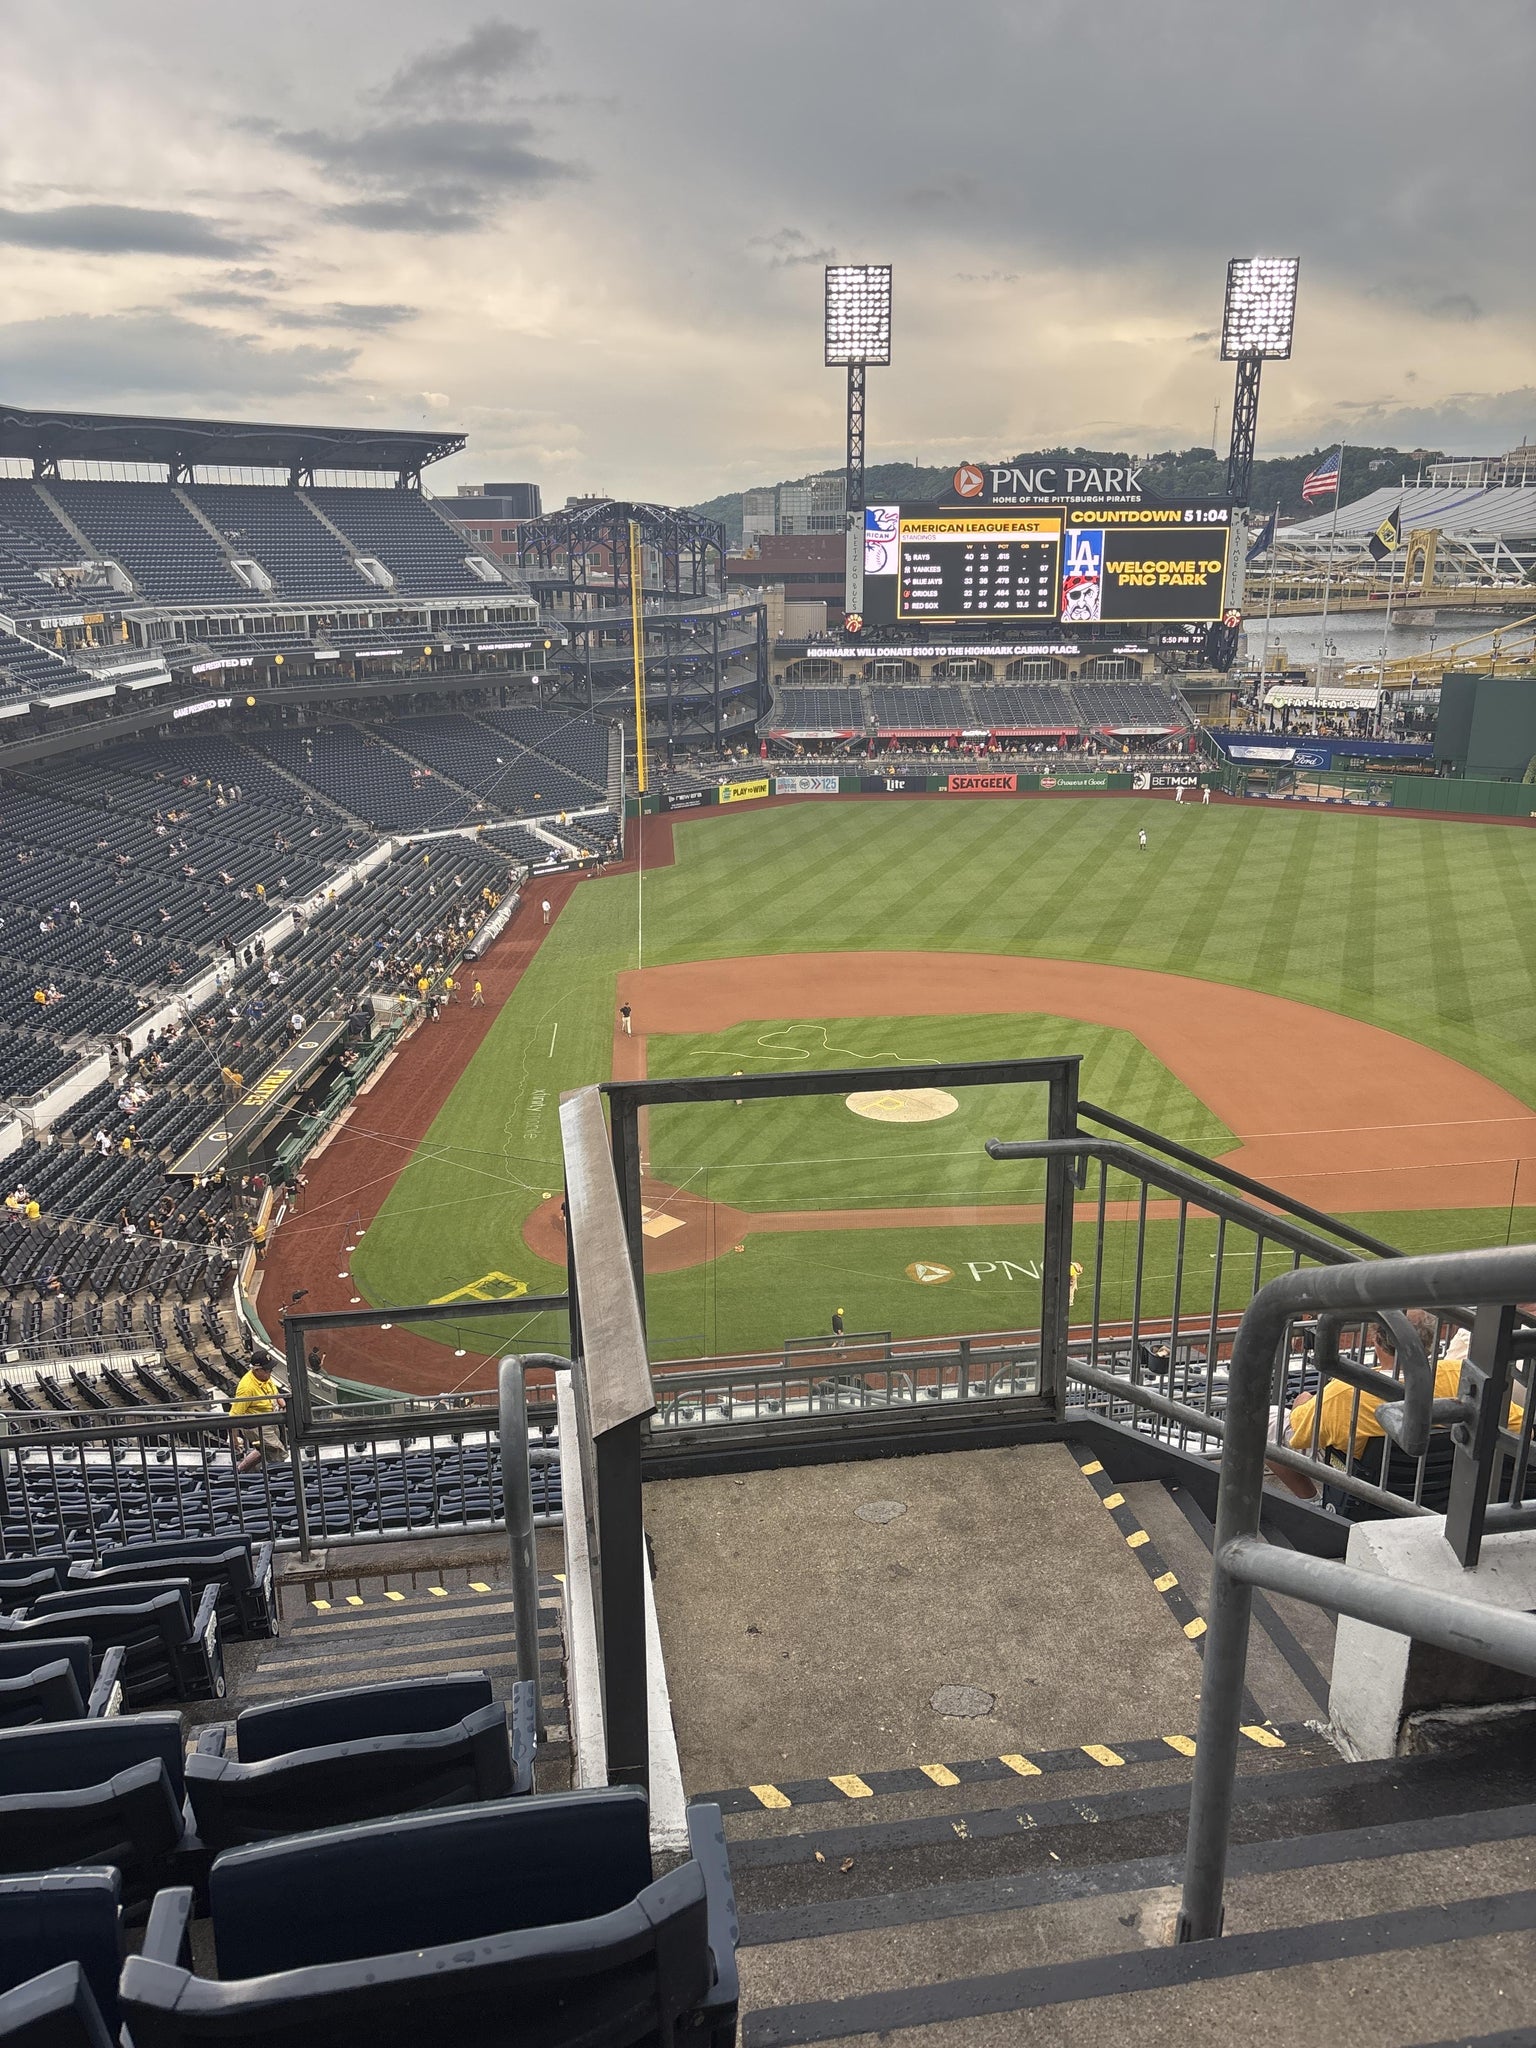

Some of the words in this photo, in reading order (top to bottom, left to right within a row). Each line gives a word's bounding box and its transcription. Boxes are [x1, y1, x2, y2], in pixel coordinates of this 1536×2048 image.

[990, 468, 1056, 494] PNC
[1064, 467, 1144, 492] PARK
[1052, 495, 1104, 503] PITTSBURGH
[1071, 510, 1182, 522] COUNTDOWN
[1184, 509, 1228, 522] 51:04
[902, 524, 964, 533] AMERICAN
[966, 523, 1009, 532] LEAGUE
[1011, 523, 1040, 532] EAST
[1105, 561, 1195, 573] WELCOME
[1198, 561, 1221, 573] TO
[1118, 574, 1157, 586] PNC
[1159, 574, 1207, 586] PARK
[1162, 636, 1177, 644] 5:50
[1177, 636, 1189, 644] PM
[807, 649, 856, 657] HIGHMARK
[857, 648, 876, 657] WILL
[877, 647, 912, 656] DONATE
[913, 647, 934, 656] $100
[935, 647, 946, 655] TO
[947, 647, 964, 655] THE
[964, 646, 1014, 655] HIGHMARK
[1014, 646, 1049, 654] CARING
[1050, 645, 1080, 654] PLACE.
[240, 658, 254, 666] BY
[218, 698, 233, 708] BY
[1294, 754, 1317, 765] Ford
[821, 778, 837, 789] 125
[886, 779, 905, 791] Lite
[952, 777, 1012, 790] SEATGEEK
[1088, 778, 1106, 786] Good
[1152, 777, 1198, 786] BETMGM
[733, 788, 748, 797] PLAY
[753, 785, 767, 793] WIN!
[242, 1069, 293, 1106] PIRATES
[962, 1260, 1043, 1282] PN
